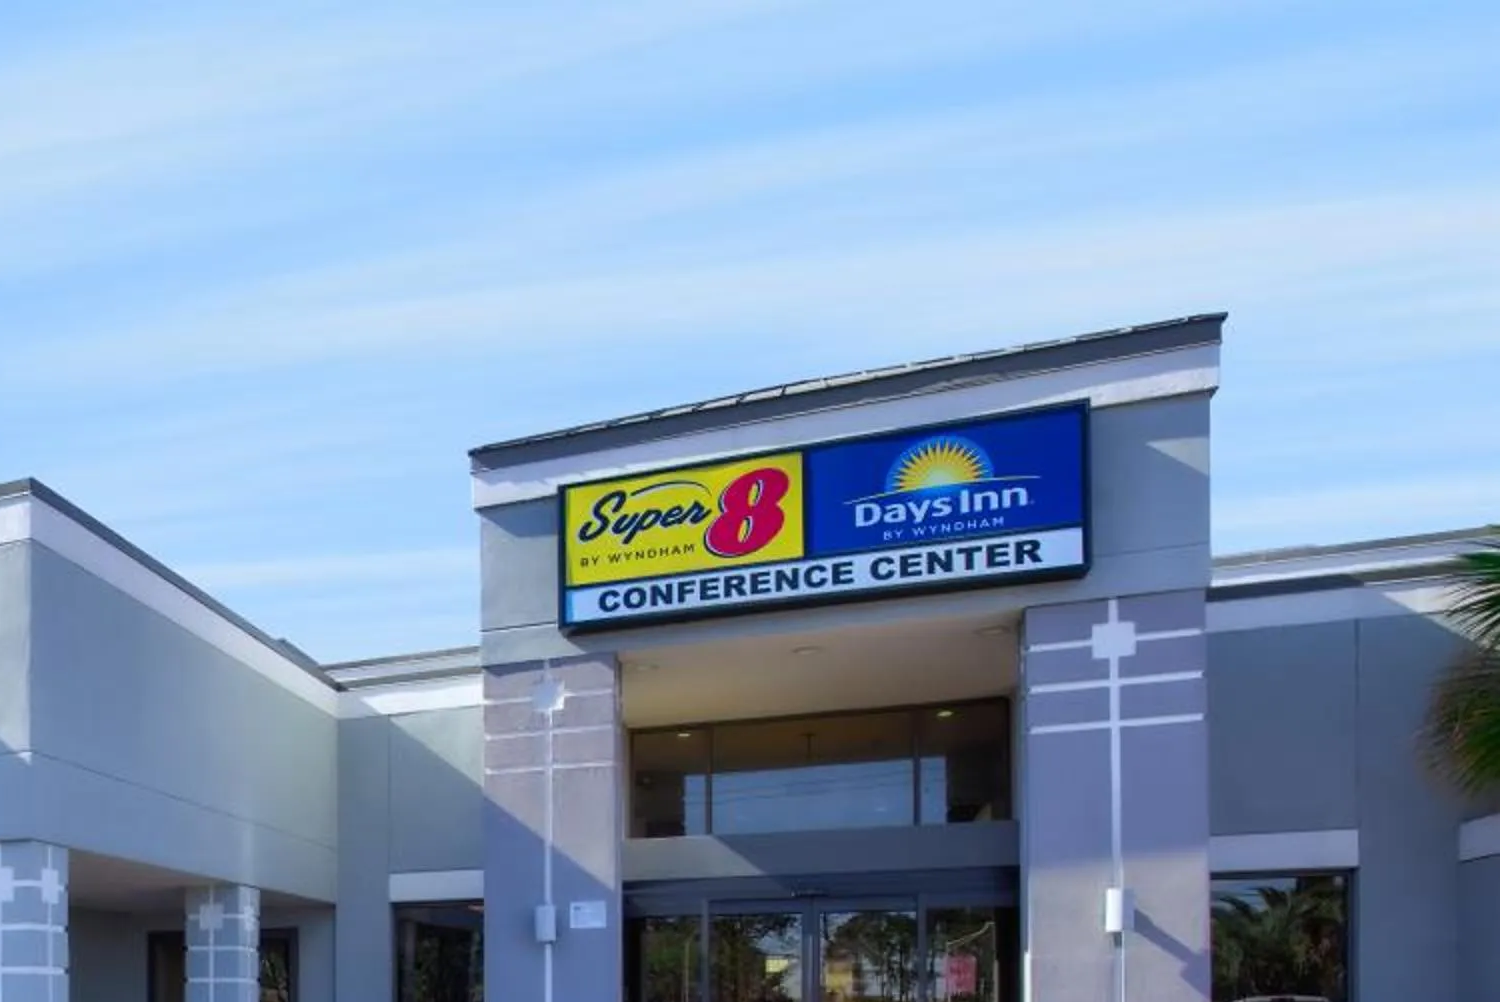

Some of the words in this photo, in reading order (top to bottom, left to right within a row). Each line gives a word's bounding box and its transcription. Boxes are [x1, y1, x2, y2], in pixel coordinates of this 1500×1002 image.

[577, 489, 713, 545] Super
[703, 466, 790, 559] 8
[854, 496, 953, 528] Days
[958, 486, 1029, 514] Inn
[883, 529, 904, 541] BY
[911, 516, 1005, 537] WYNDHAM
[579, 556, 601, 568] BY
[607, 543, 696, 565] WYNDHAM
[597, 561, 855, 613] CONFERENCE
[869, 539, 1043, 581] CENTER
